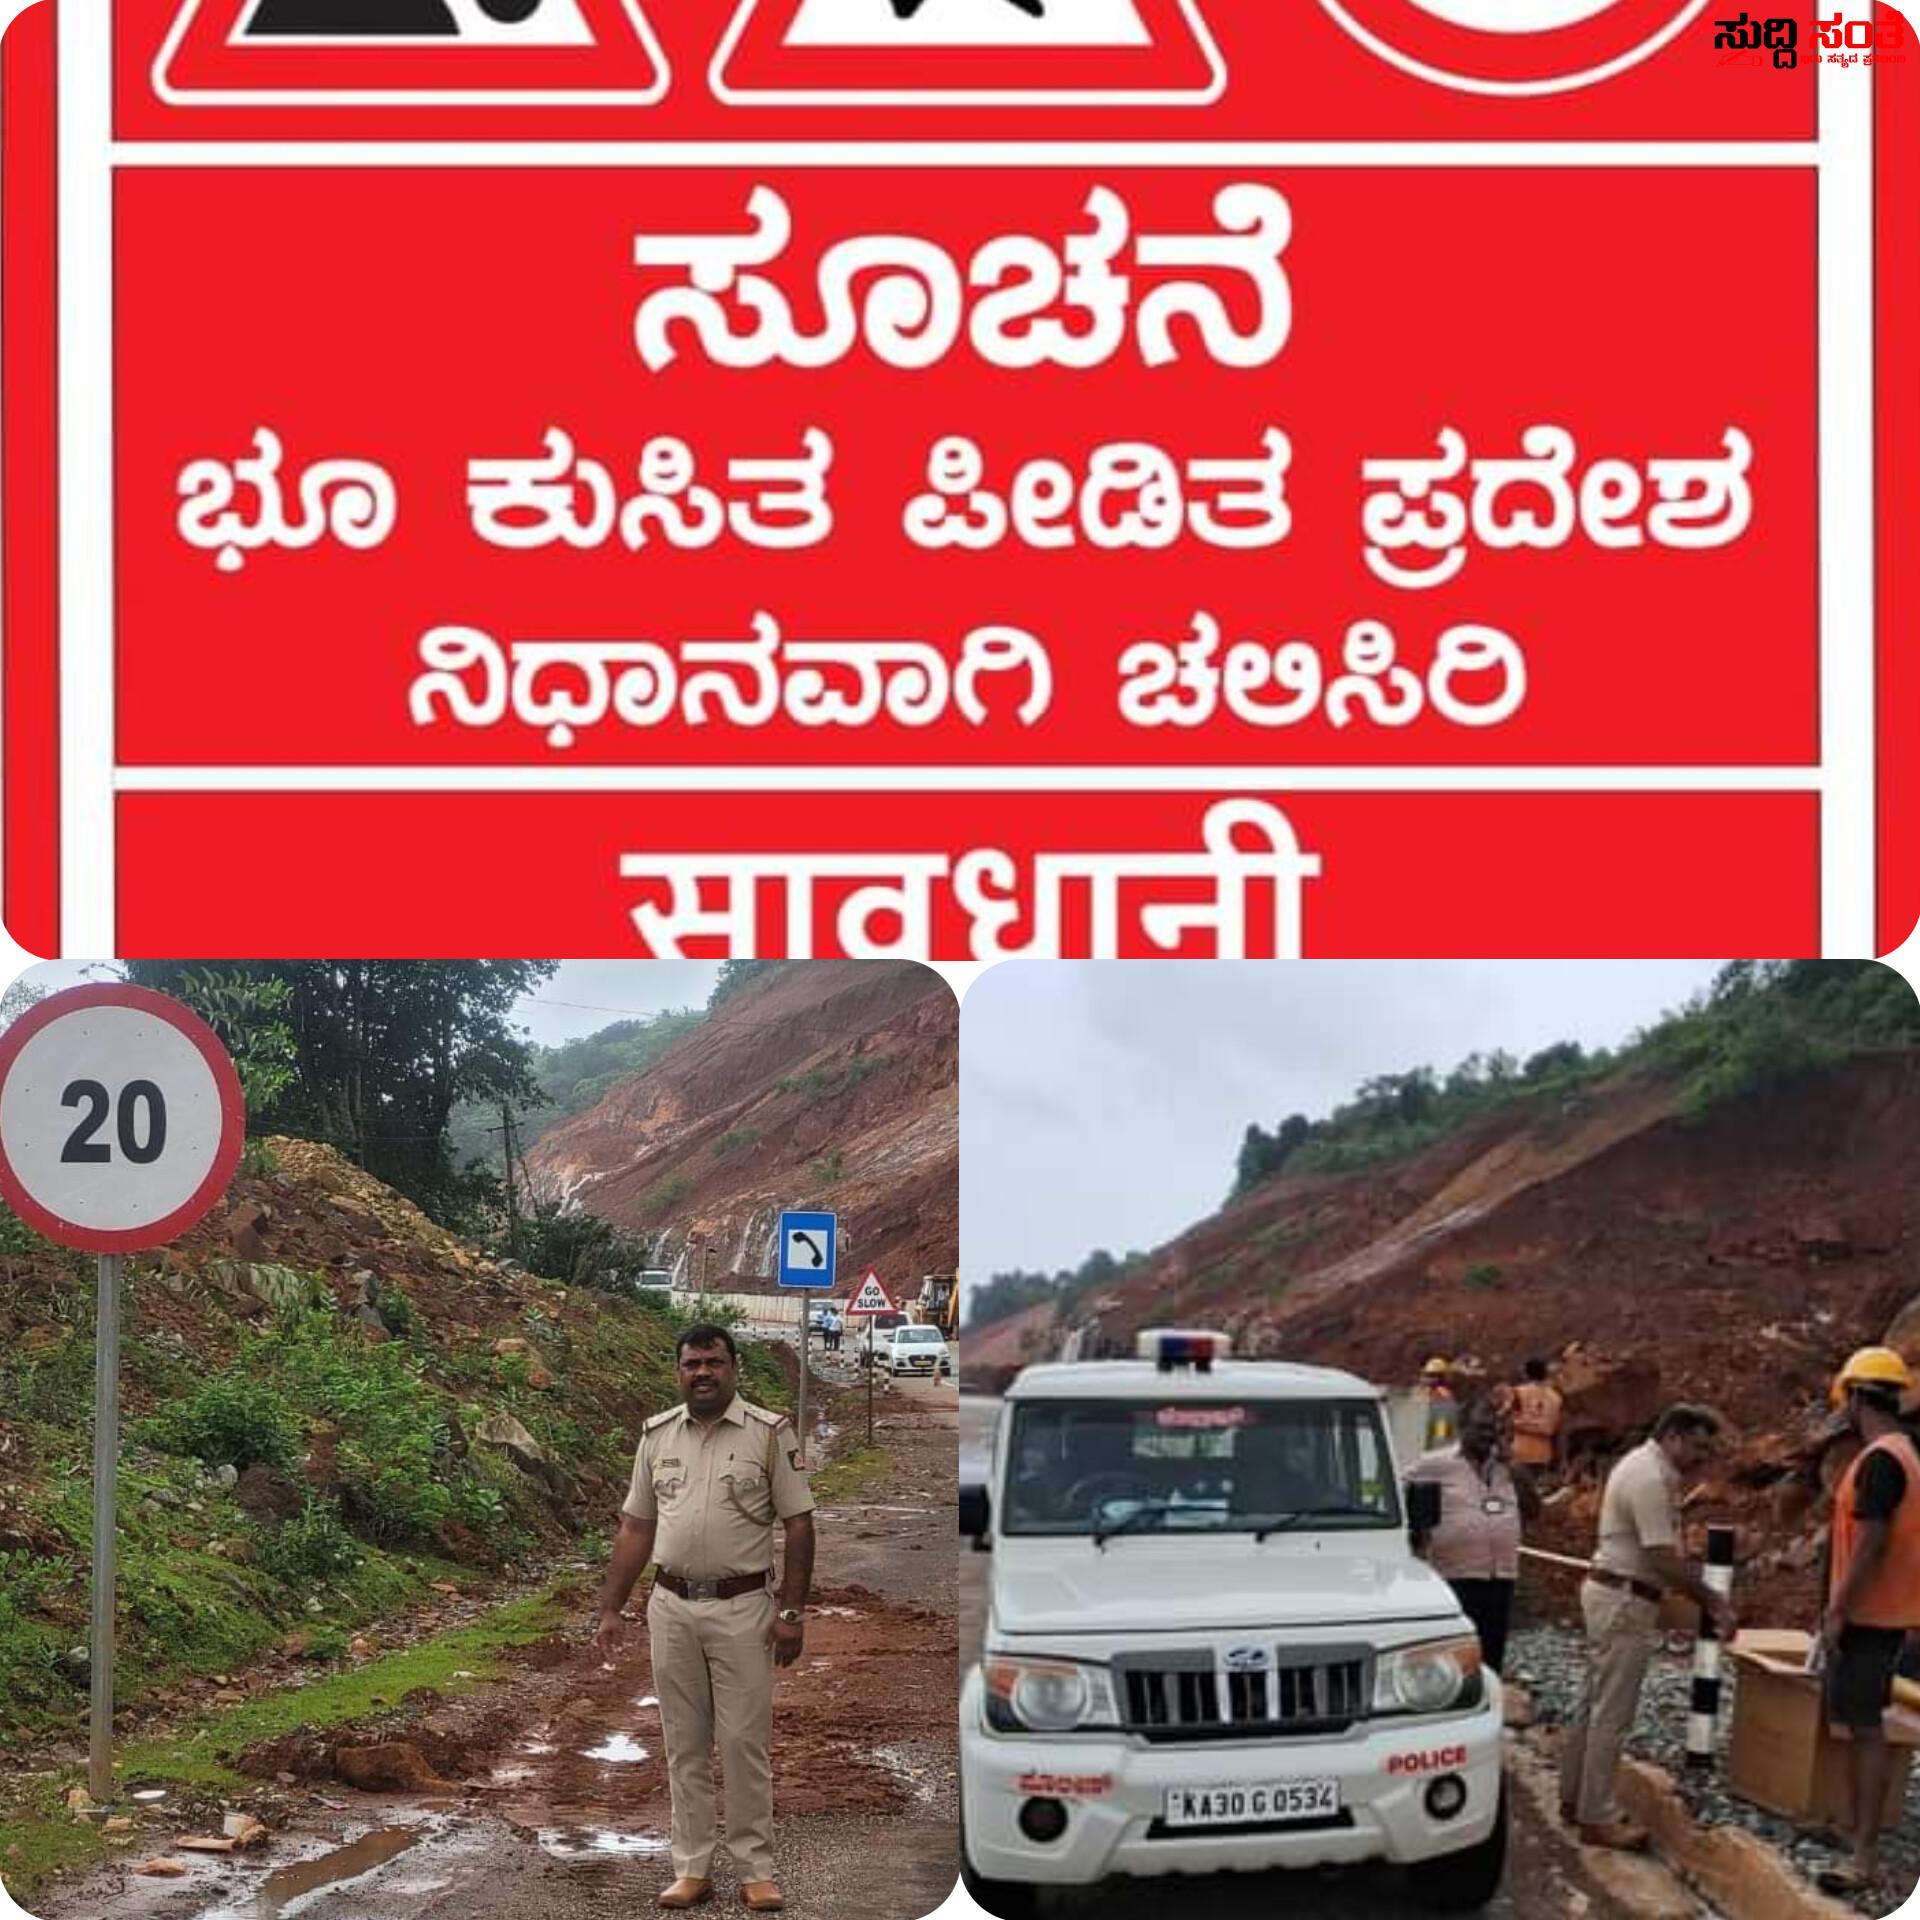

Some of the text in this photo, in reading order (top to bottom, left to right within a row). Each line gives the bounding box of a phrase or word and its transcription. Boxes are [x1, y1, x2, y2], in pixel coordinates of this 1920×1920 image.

[634, 183, 1292, 372] ಸೂಚನೆ
[177, 425, 1752, 589] ಭೂ ಕುಸಿತ ಪೀಡಿತ ಪ್ರದೇಶ
[409, 611, 1526, 747] ನಿಧಾನವಾಗಿ ಚಲಿಸಿರಿ
[619, 798, 1321, 959] सावधानी
[60, 1079, 167, 1164] 20
[857, 1298, 886, 1308] SLOW
[864, 1286, 880, 1296] GO
[1183, 1784, 1334, 1819] KA30 G 0534
[1388, 1744, 1467, 1774] POLICE
